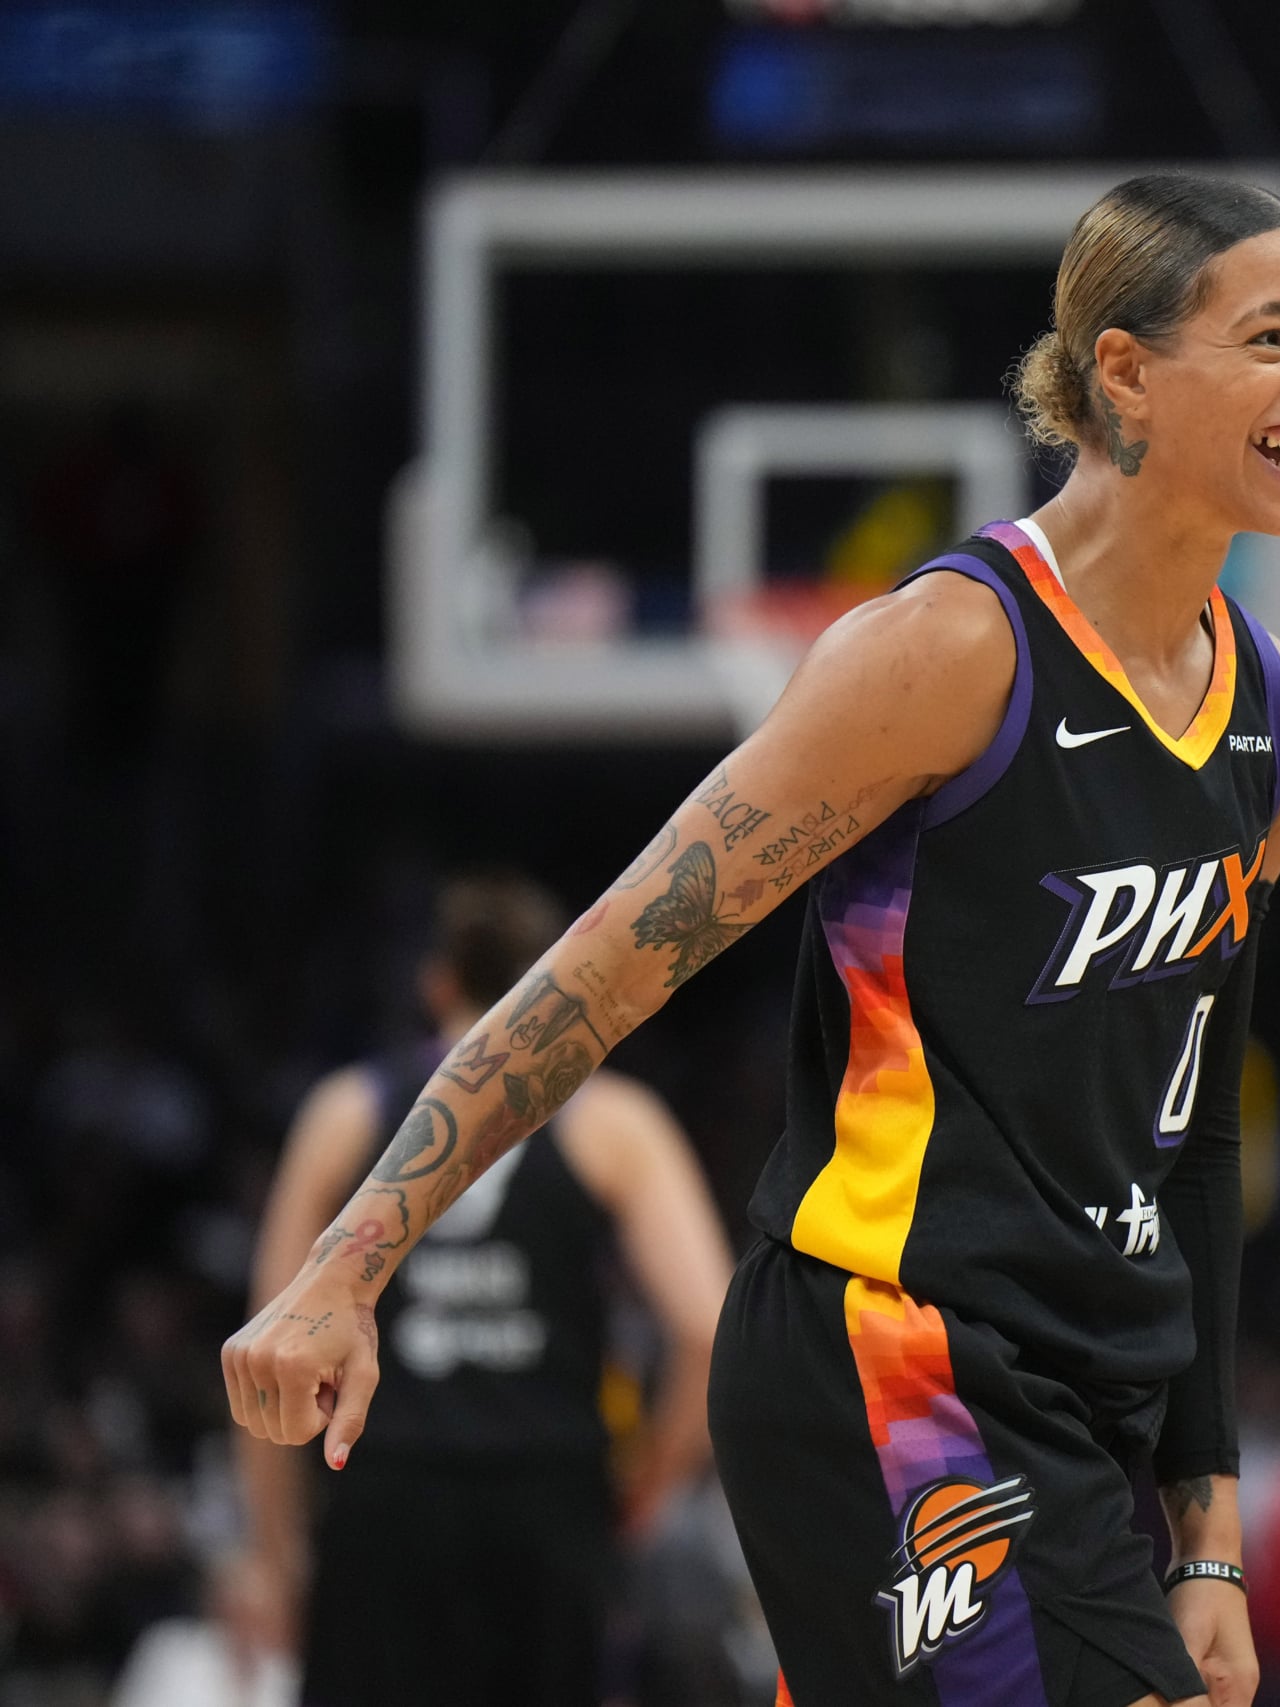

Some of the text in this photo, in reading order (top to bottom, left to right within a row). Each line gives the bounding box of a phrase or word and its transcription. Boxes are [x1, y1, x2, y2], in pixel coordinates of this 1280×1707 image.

[1228, 734, 1273, 753] PARTAK
[1048, 836, 1268, 990] PHX
[1156, 994, 1216, 1138] 0
[1183, 1561, 1230, 1578] FREE
